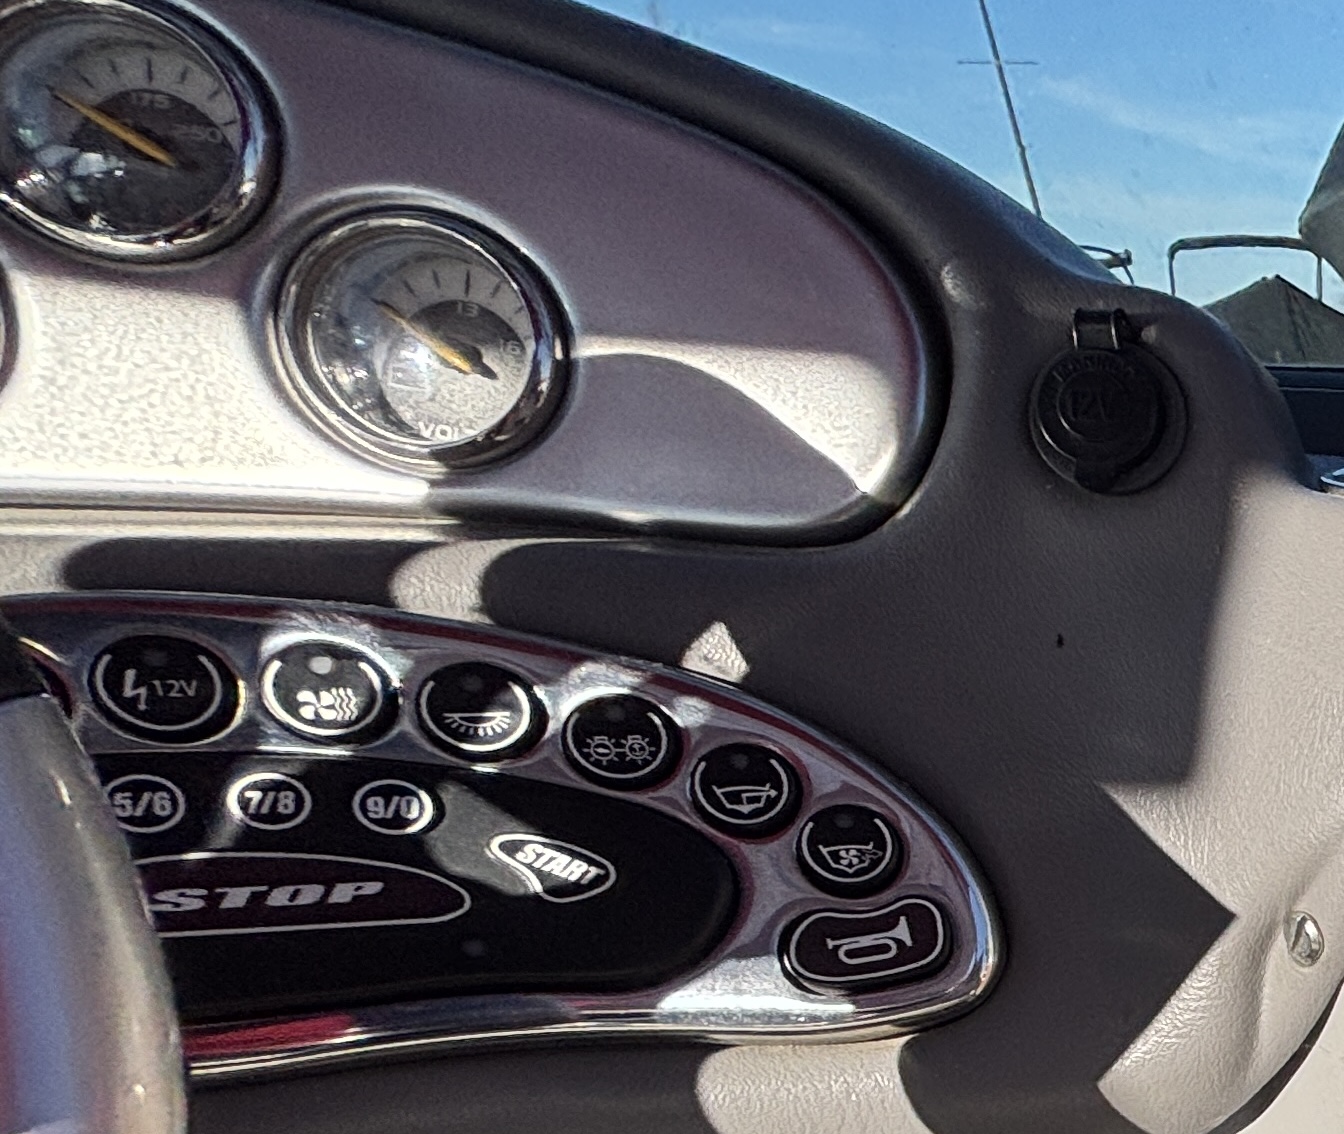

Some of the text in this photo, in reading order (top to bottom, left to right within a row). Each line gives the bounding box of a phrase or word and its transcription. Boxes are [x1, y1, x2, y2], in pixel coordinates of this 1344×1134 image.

[151, 679, 197, 697] 12V
[244, 789, 296, 815] 7/8
[366, 792, 420, 819] 9/0
[515, 842, 606, 884] START
[150, 880, 385, 912] STOP
